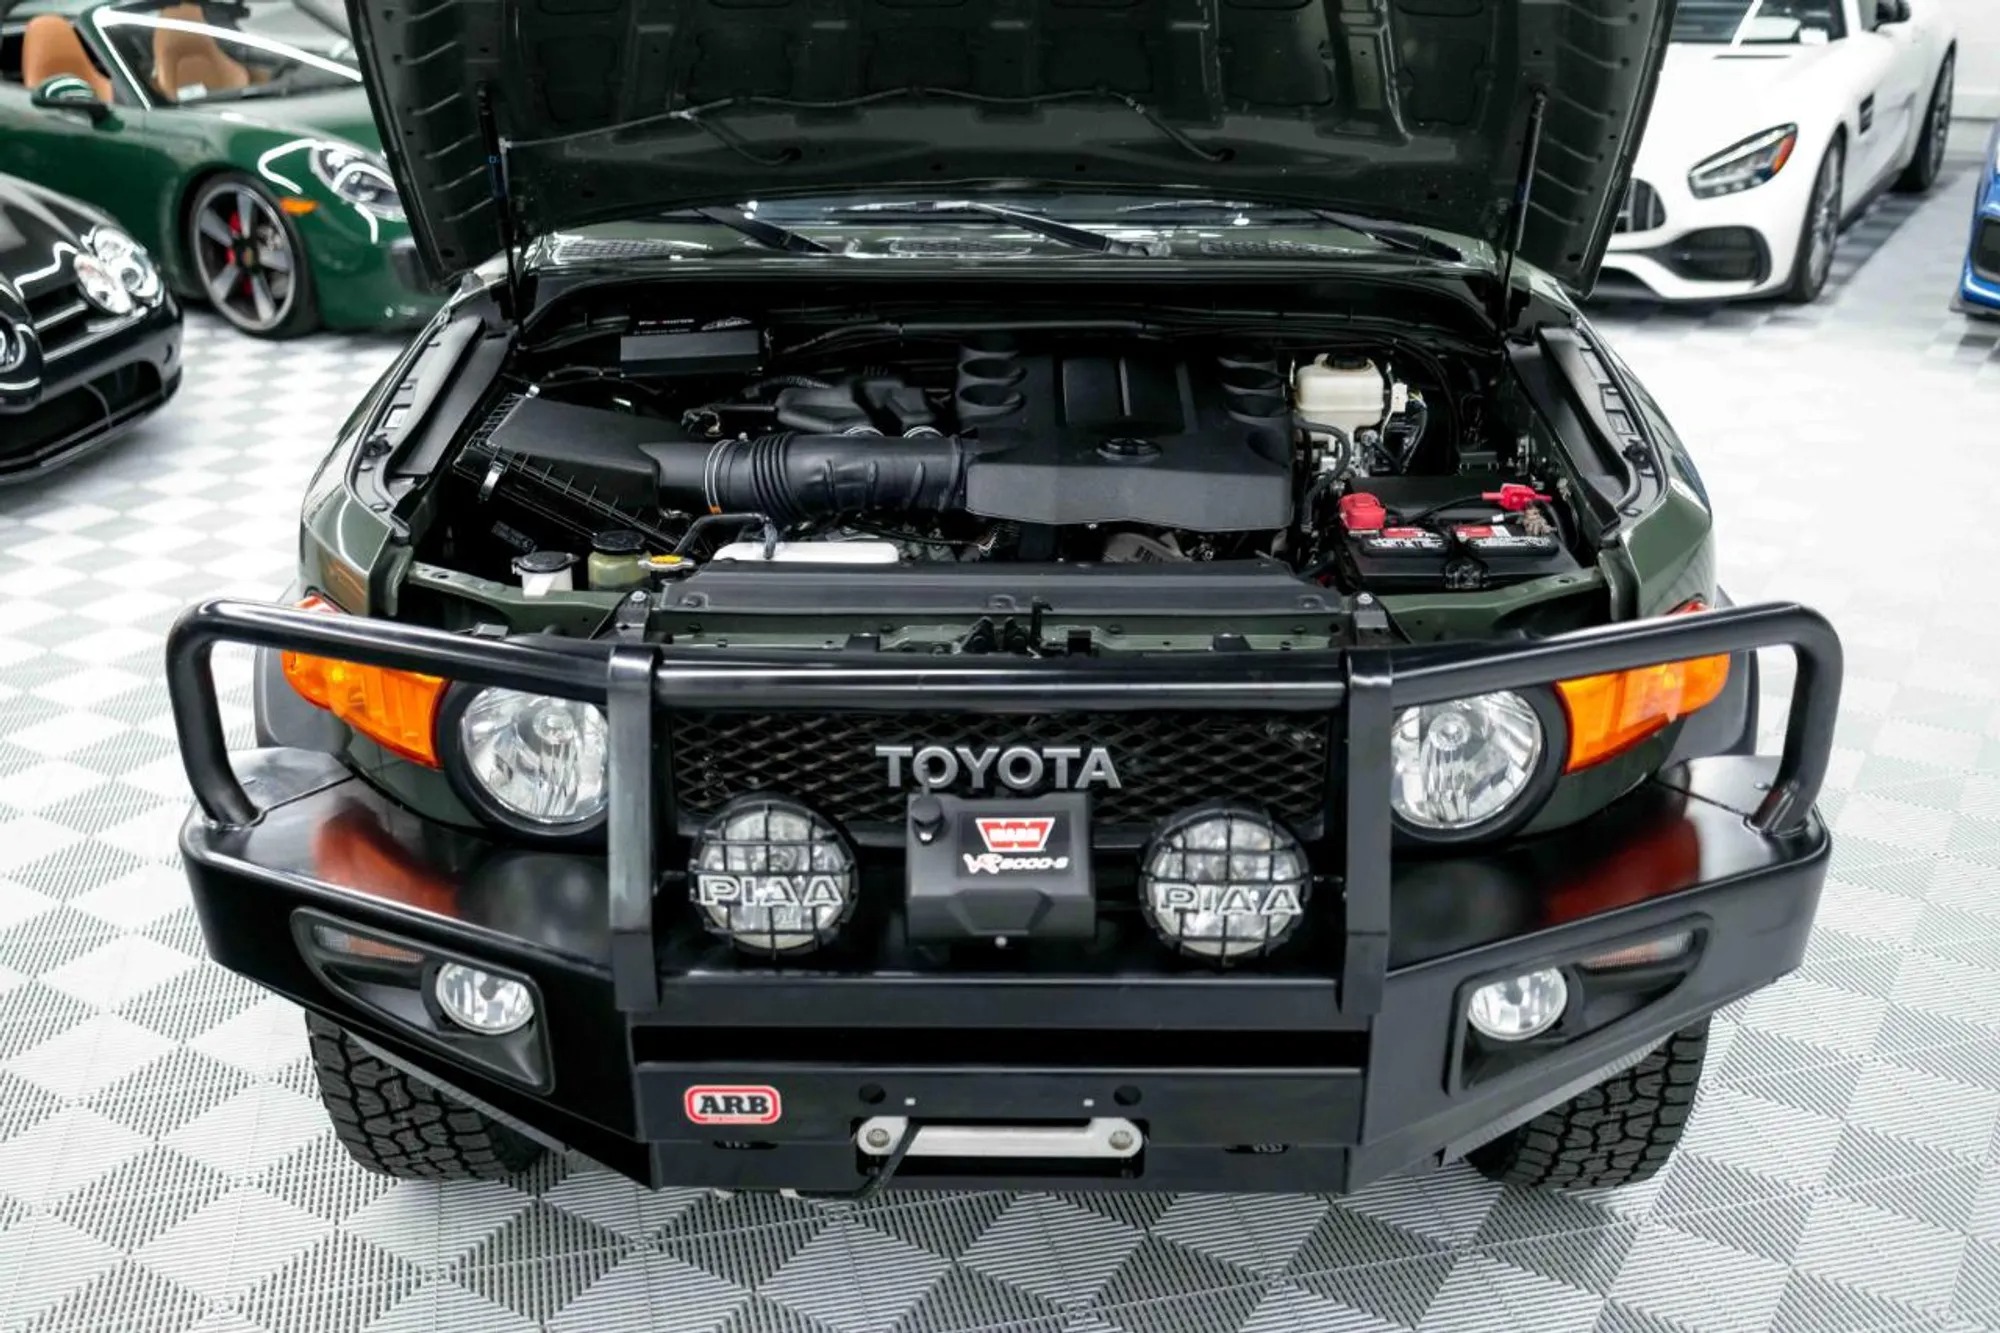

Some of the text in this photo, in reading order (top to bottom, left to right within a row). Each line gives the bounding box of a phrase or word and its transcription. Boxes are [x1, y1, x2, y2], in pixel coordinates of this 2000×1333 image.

[875, 745, 1122, 790] TOYOTA
[698, 875, 842, 906] PIAA
[1157, 883, 1302, 915] PIAA
[699, 1095, 769, 1114] ARB
